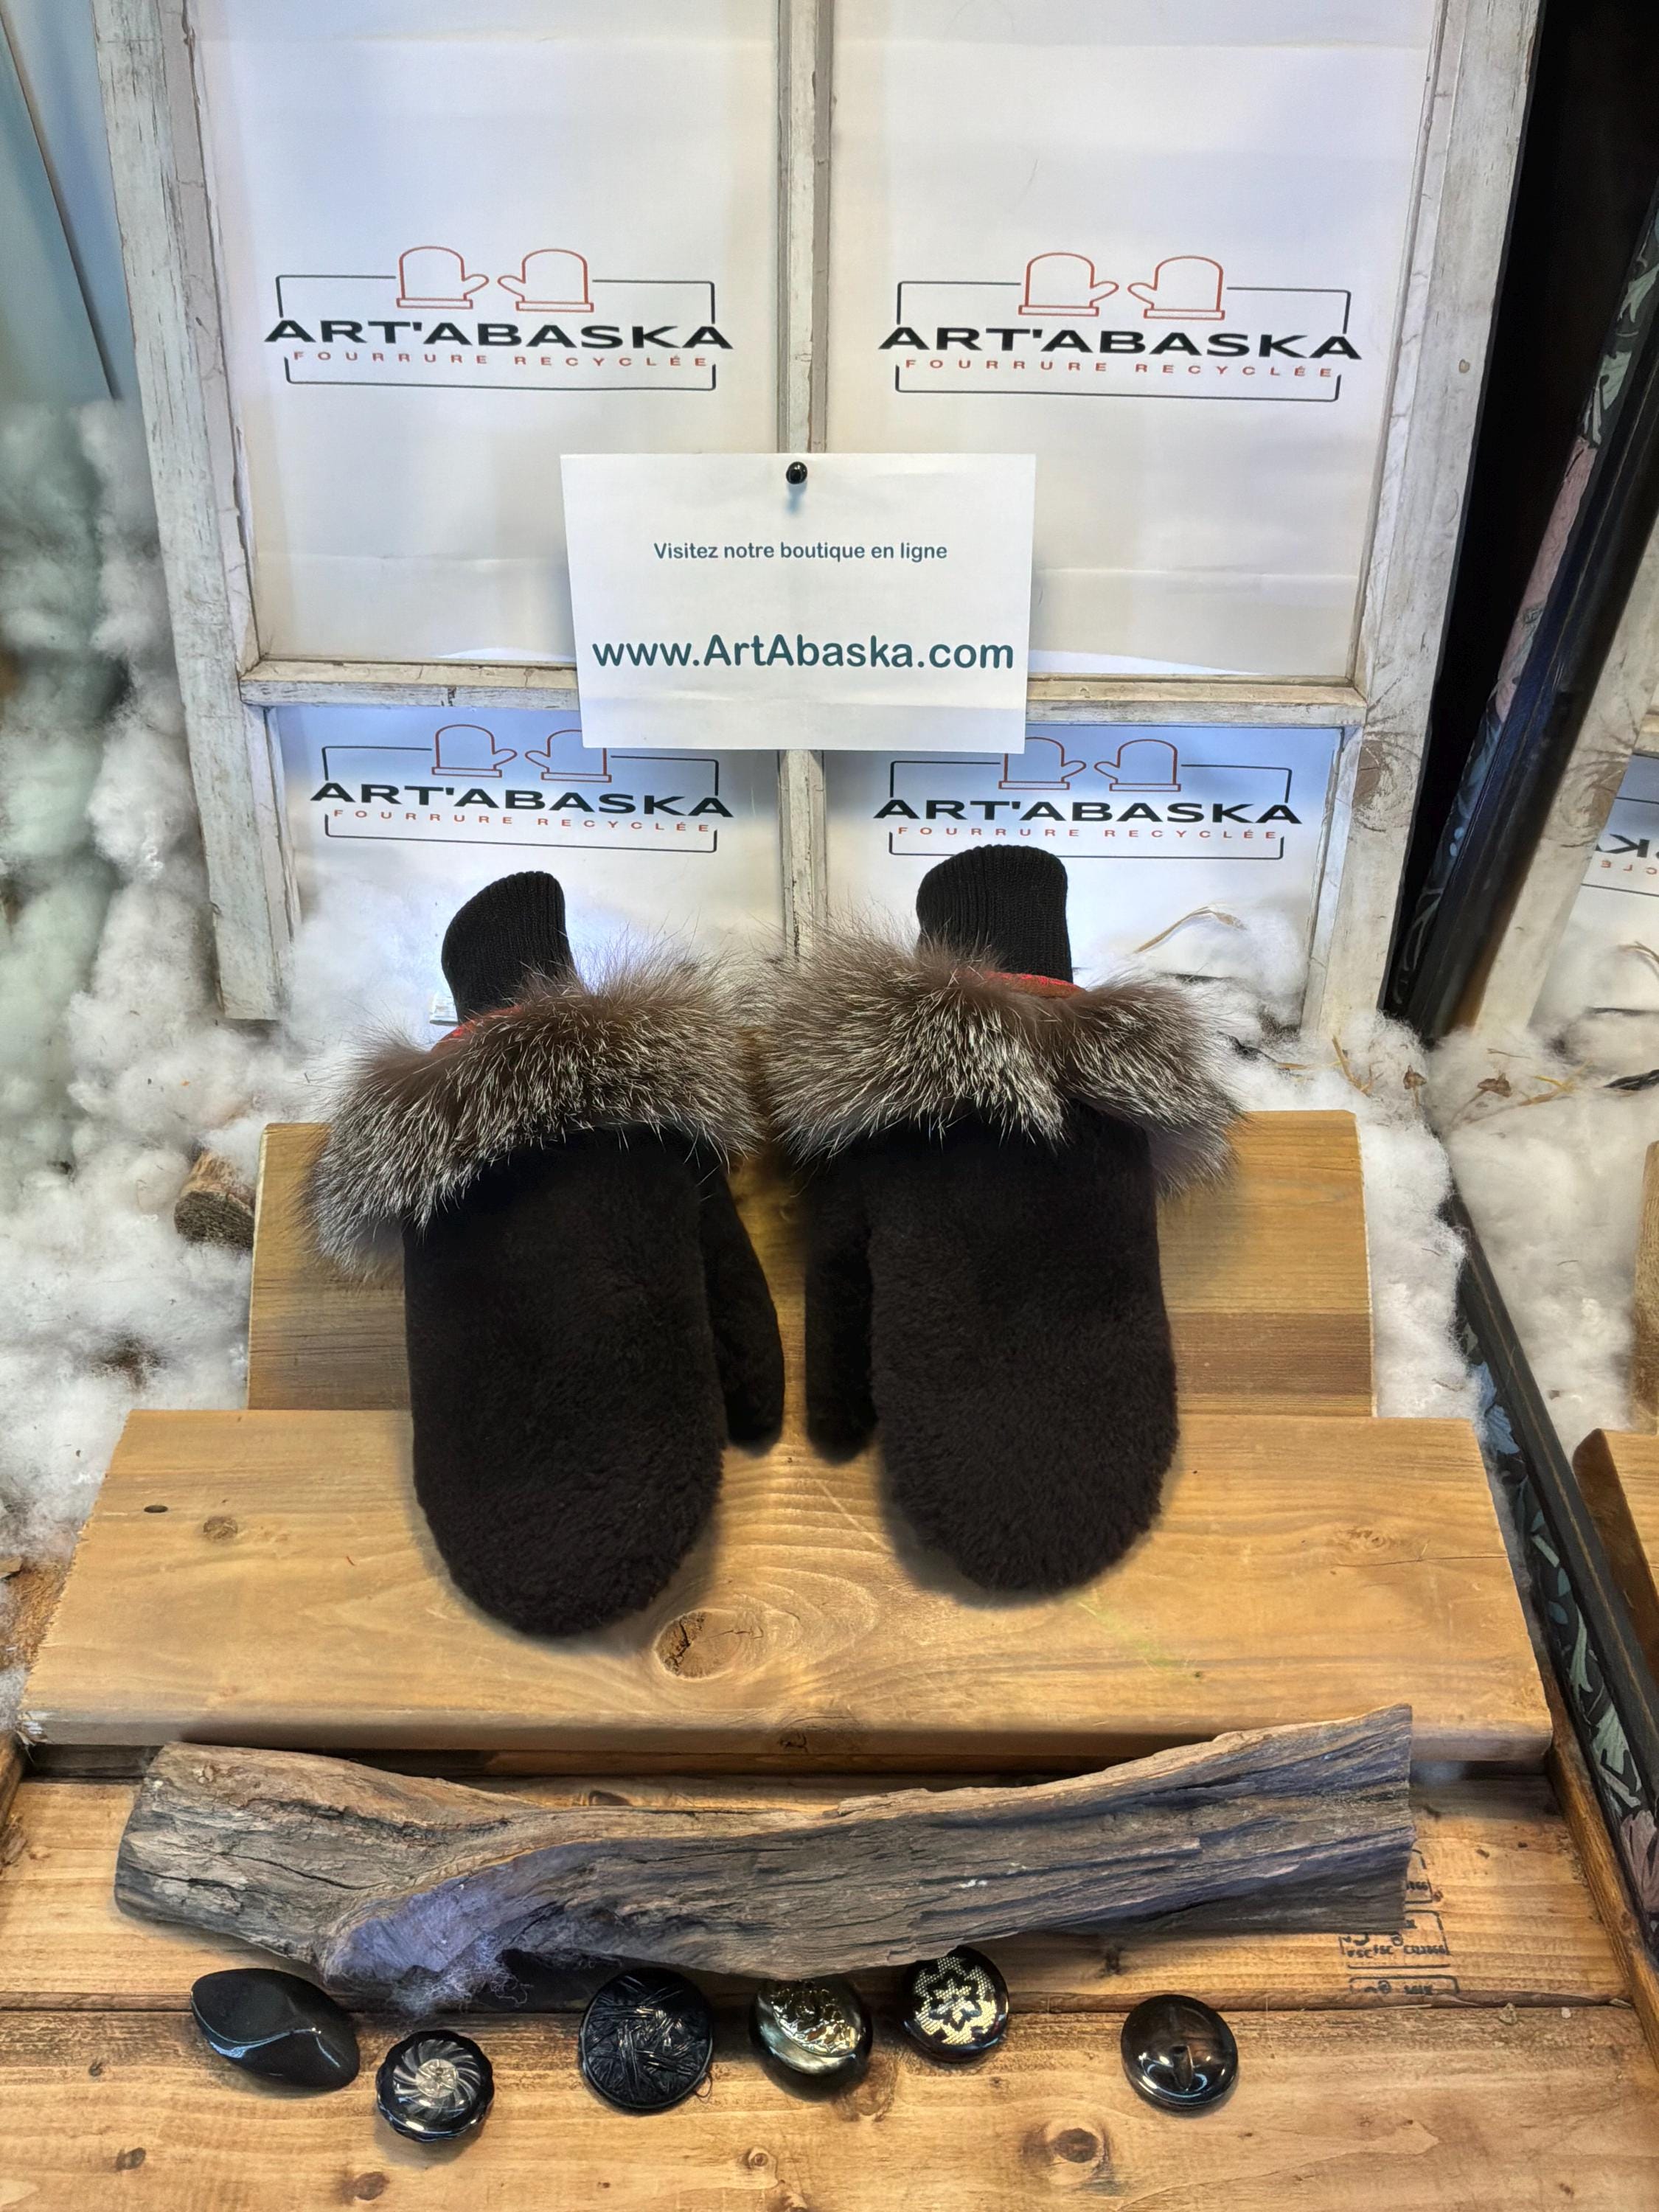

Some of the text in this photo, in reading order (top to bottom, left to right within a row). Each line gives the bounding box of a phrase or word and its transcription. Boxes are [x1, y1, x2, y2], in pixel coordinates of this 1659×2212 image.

[264, 320, 734, 349] ART'ABASKA
[878, 327, 1362, 360] ART'ABASKA
[293, 351, 707, 367] FOURRURE RECYCLÉE
[905, 358, 1332, 378] FOURRURE RECYCLÉE
[653, 542, 947, 563] Visitez notre boutique en ligne
[591, 633, 1015, 669] www.ArtAbaska.com
[310, 782, 734, 818] ART'ABASKA
[872, 799, 1302, 824] ART'ABASKA
[333, 810, 710, 832] FOURRURE RECYCLÉE
[897, 826, 1277, 840] FOURRURE RECYCLÉE
